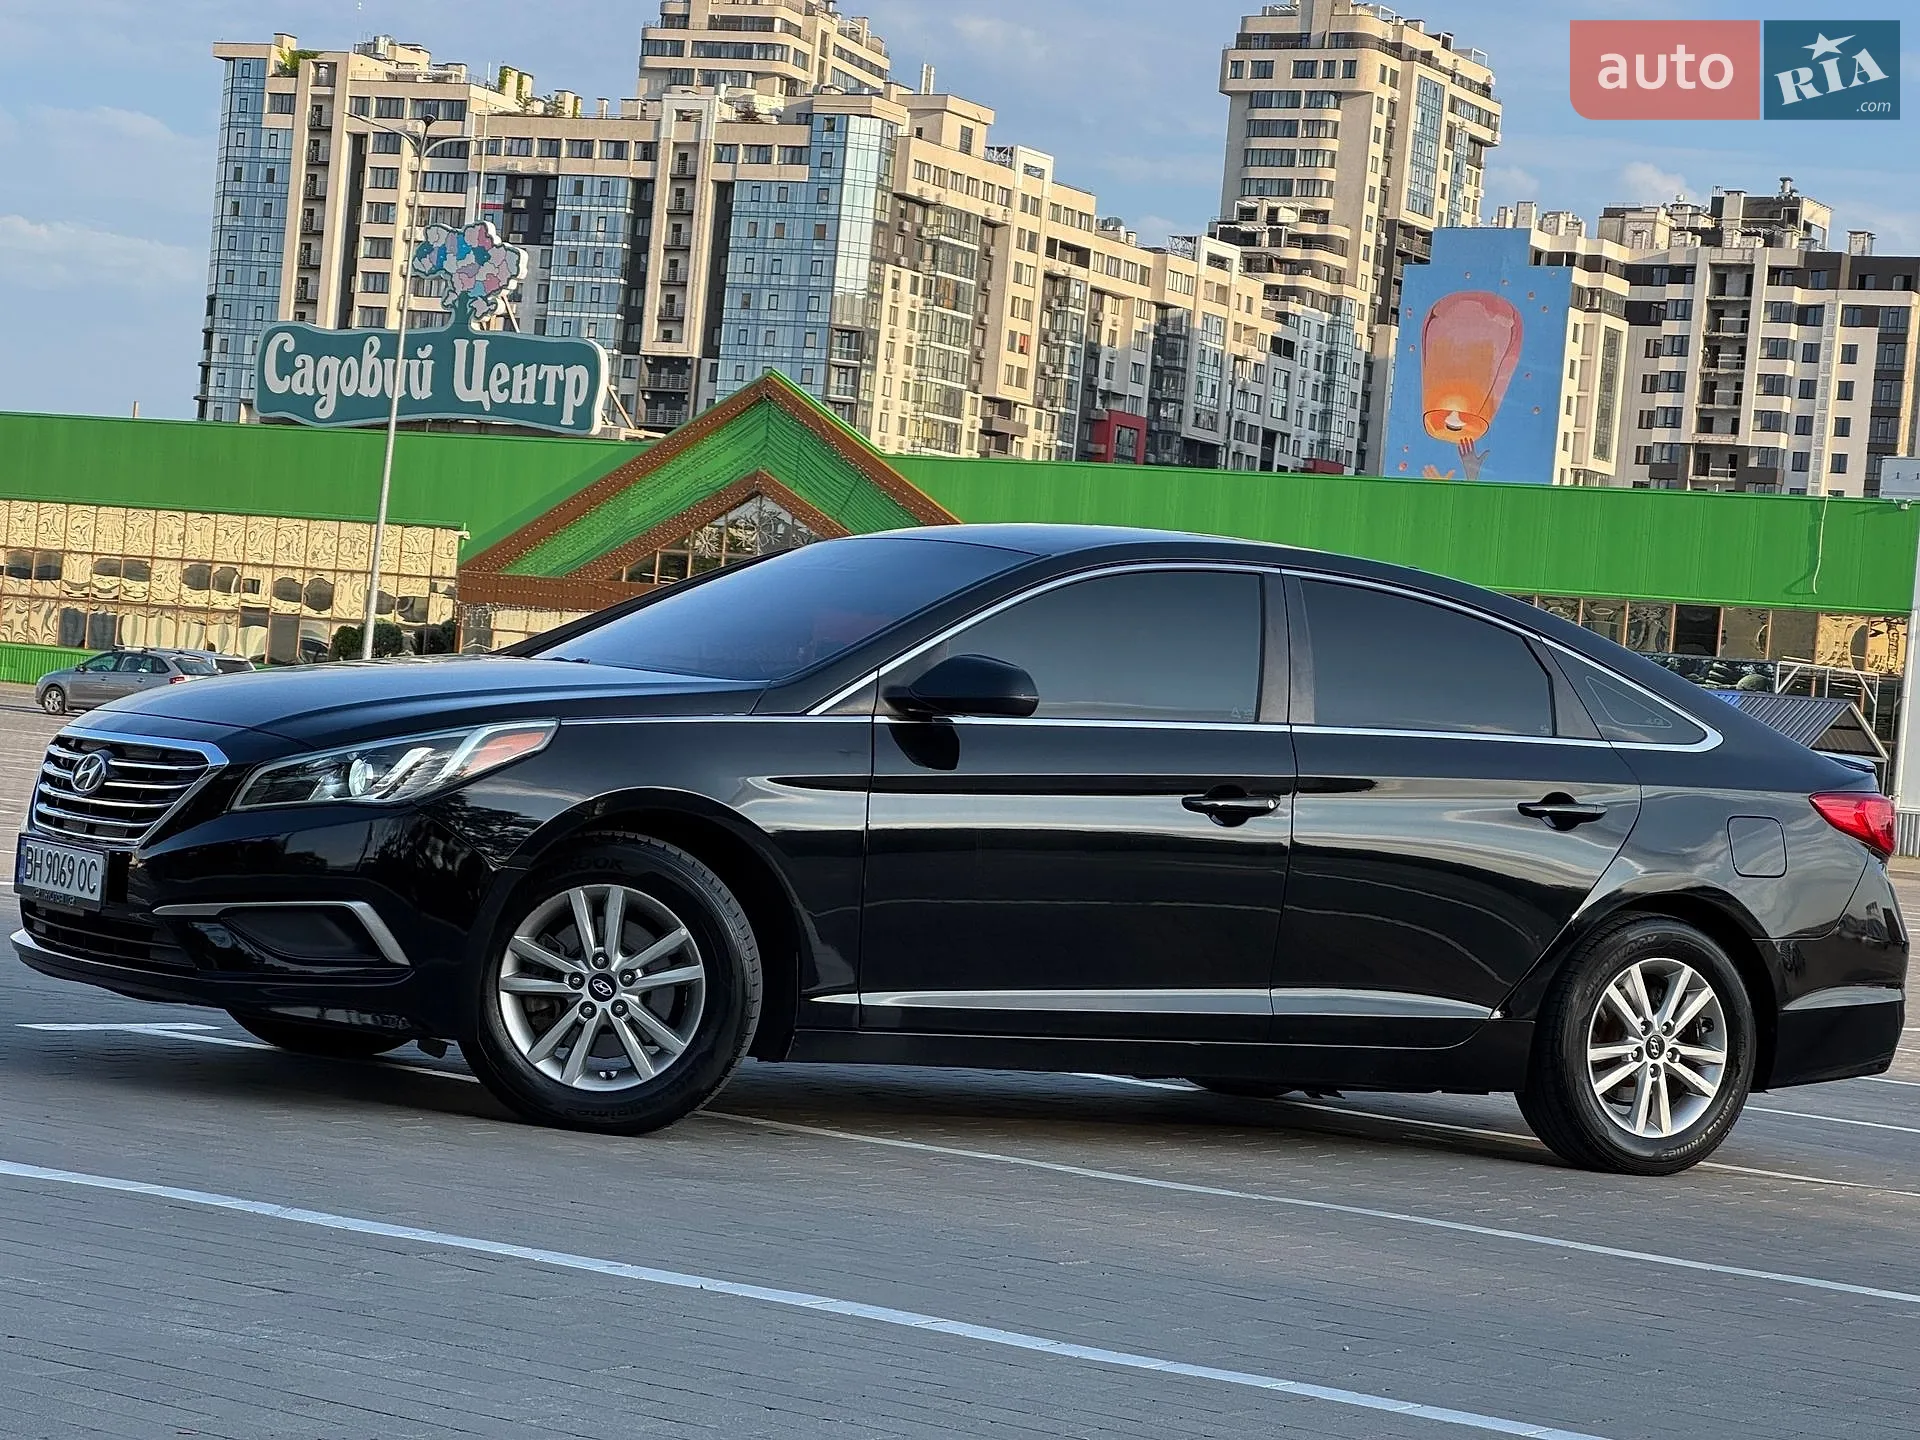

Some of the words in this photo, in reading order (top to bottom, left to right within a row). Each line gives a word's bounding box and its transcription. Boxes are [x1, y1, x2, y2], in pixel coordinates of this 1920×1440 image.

[264, 332, 434, 419] Садовий
[453, 339, 588, 426] Центр
[25, 846, 44, 883] BH
[44, 850, 75, 889] 9069
[77, 858, 98, 895] OC
